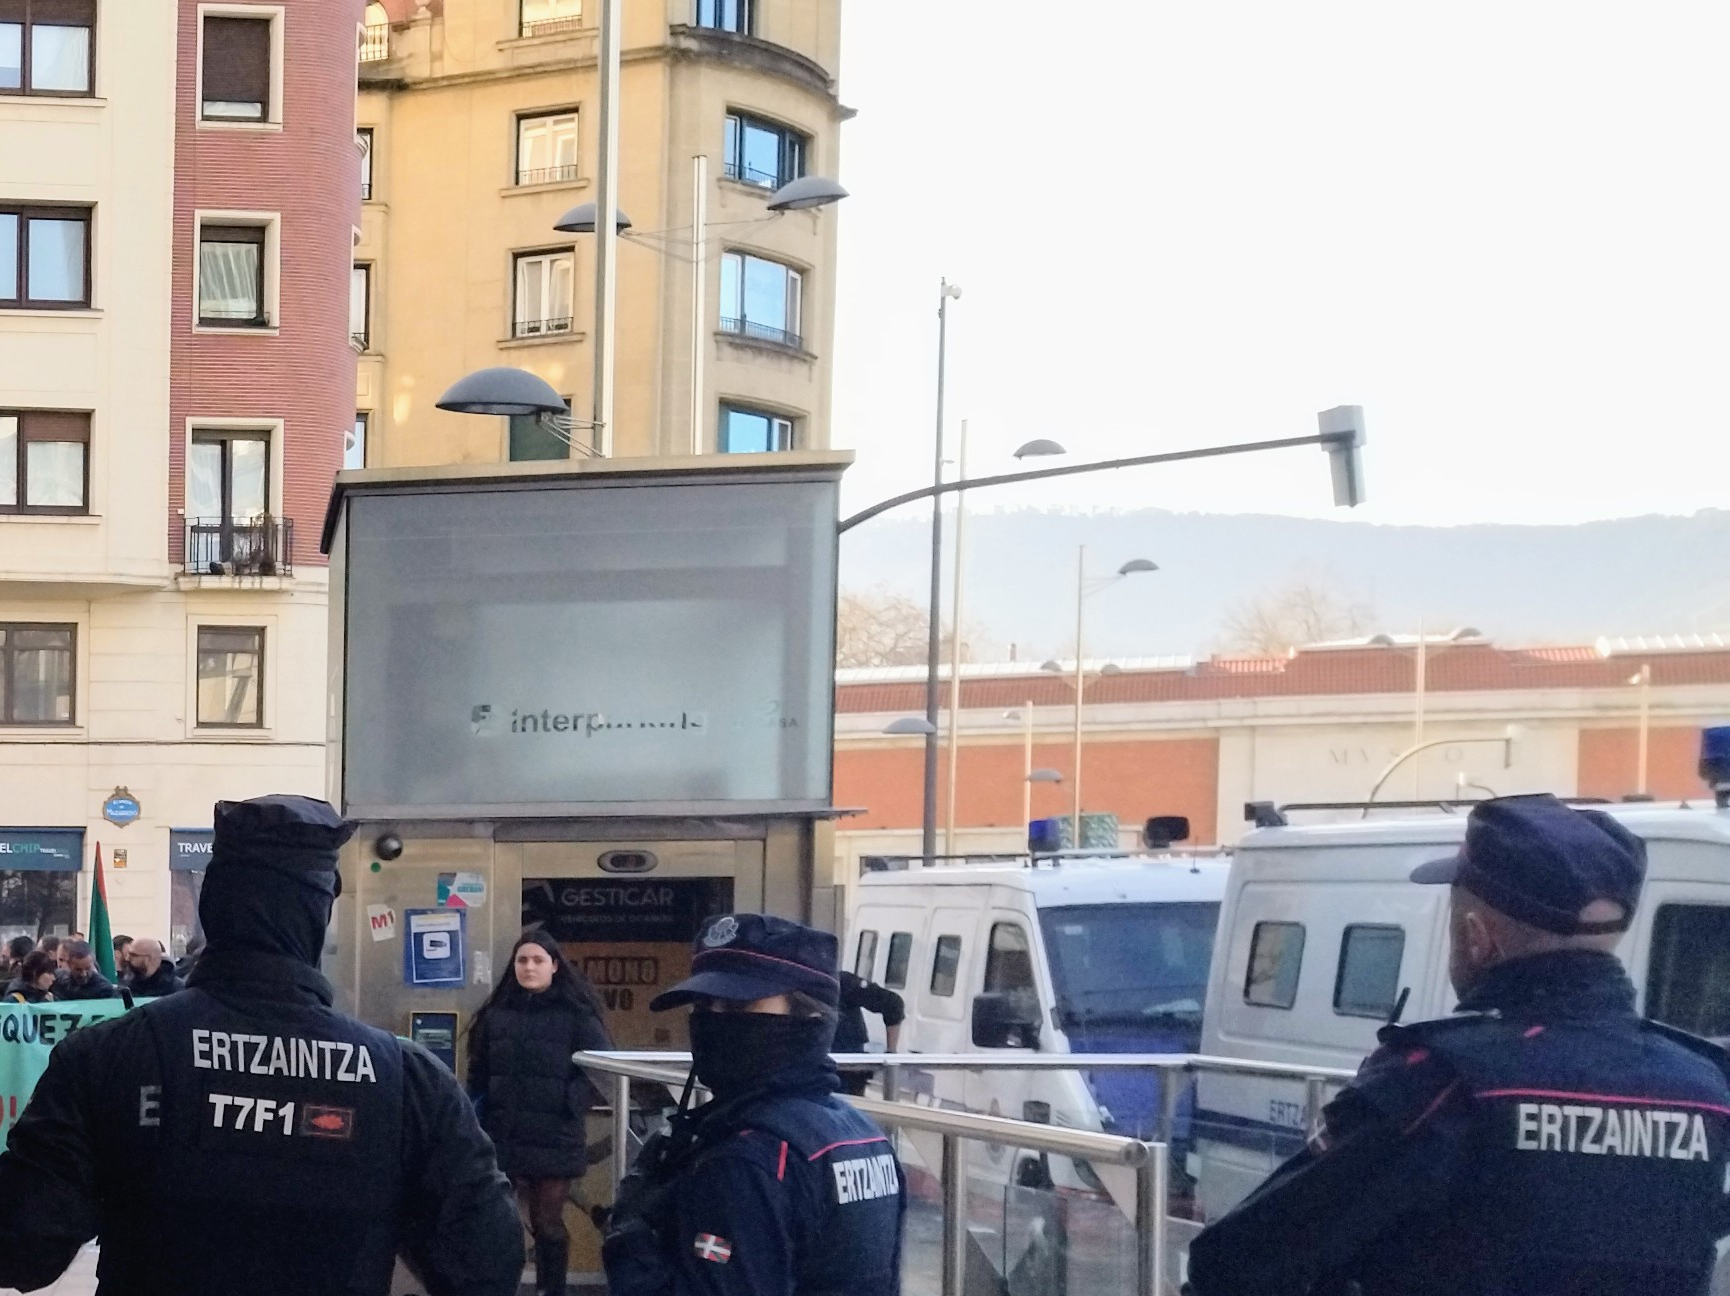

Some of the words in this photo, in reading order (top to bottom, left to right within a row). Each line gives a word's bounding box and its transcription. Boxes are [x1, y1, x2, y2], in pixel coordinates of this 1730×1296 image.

[561, 887, 674, 906] GESTICAR
[192, 1028, 377, 1083] ERTZAINTZA
[208, 1093, 295, 1135] T7F1
[1516, 1103, 1710, 1162] ERTZAINTZA
